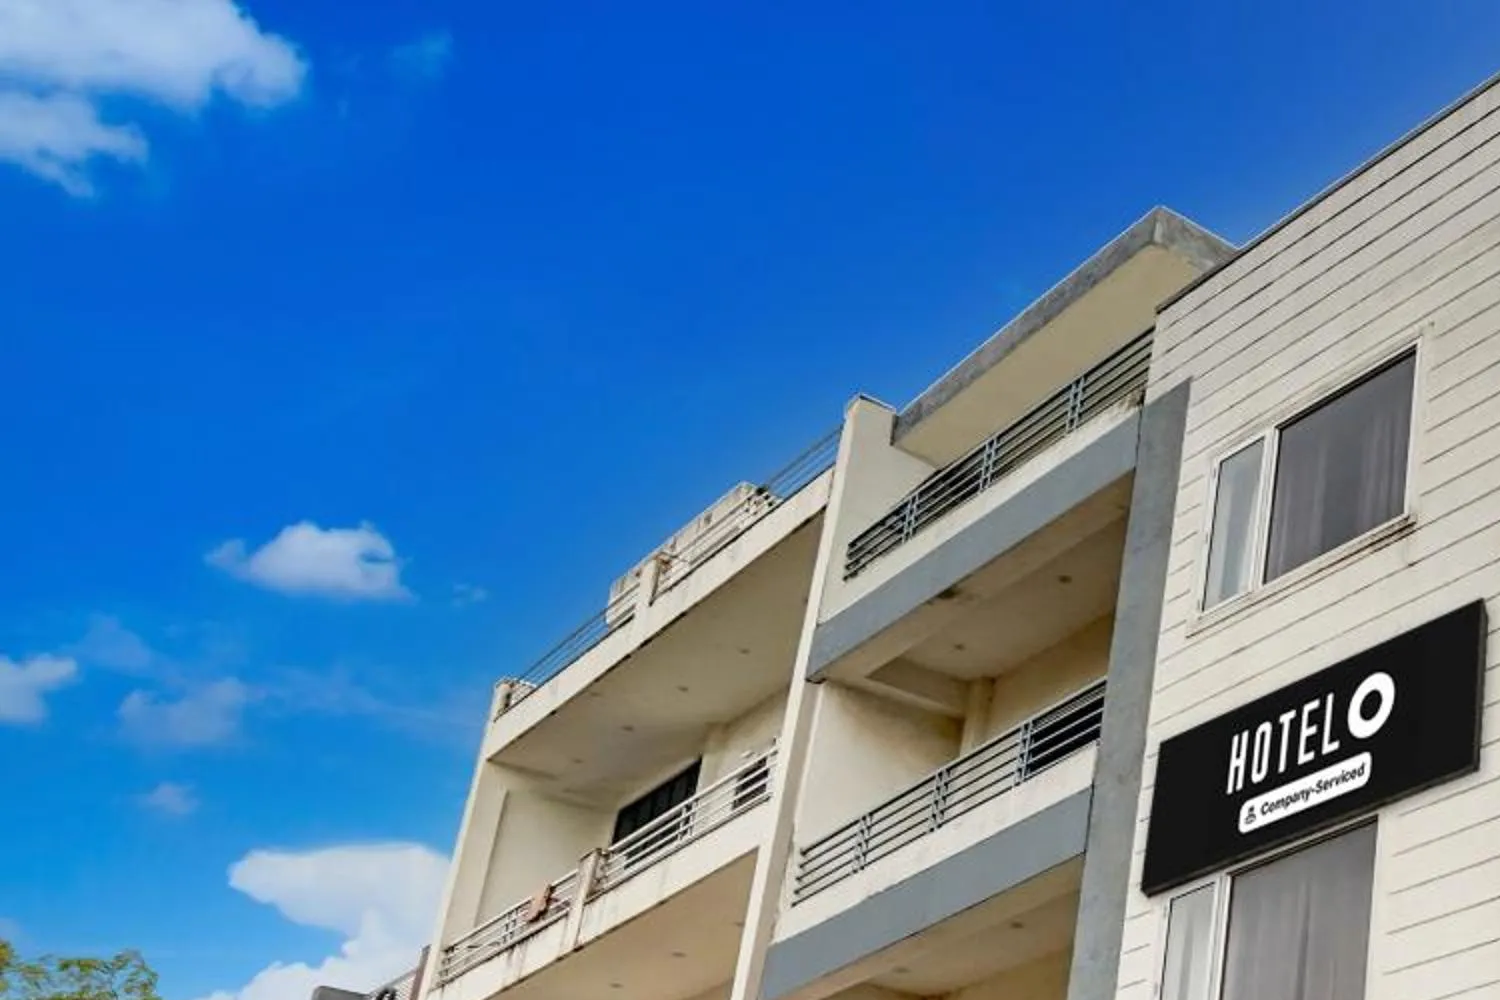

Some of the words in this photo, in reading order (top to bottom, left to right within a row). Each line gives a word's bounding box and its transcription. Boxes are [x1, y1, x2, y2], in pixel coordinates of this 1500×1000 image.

[1226, 692, 1340, 795] HOTEL
[1347, 671, 1396, 739] O
[1260, 762, 1366, 816] Company-Serviced
